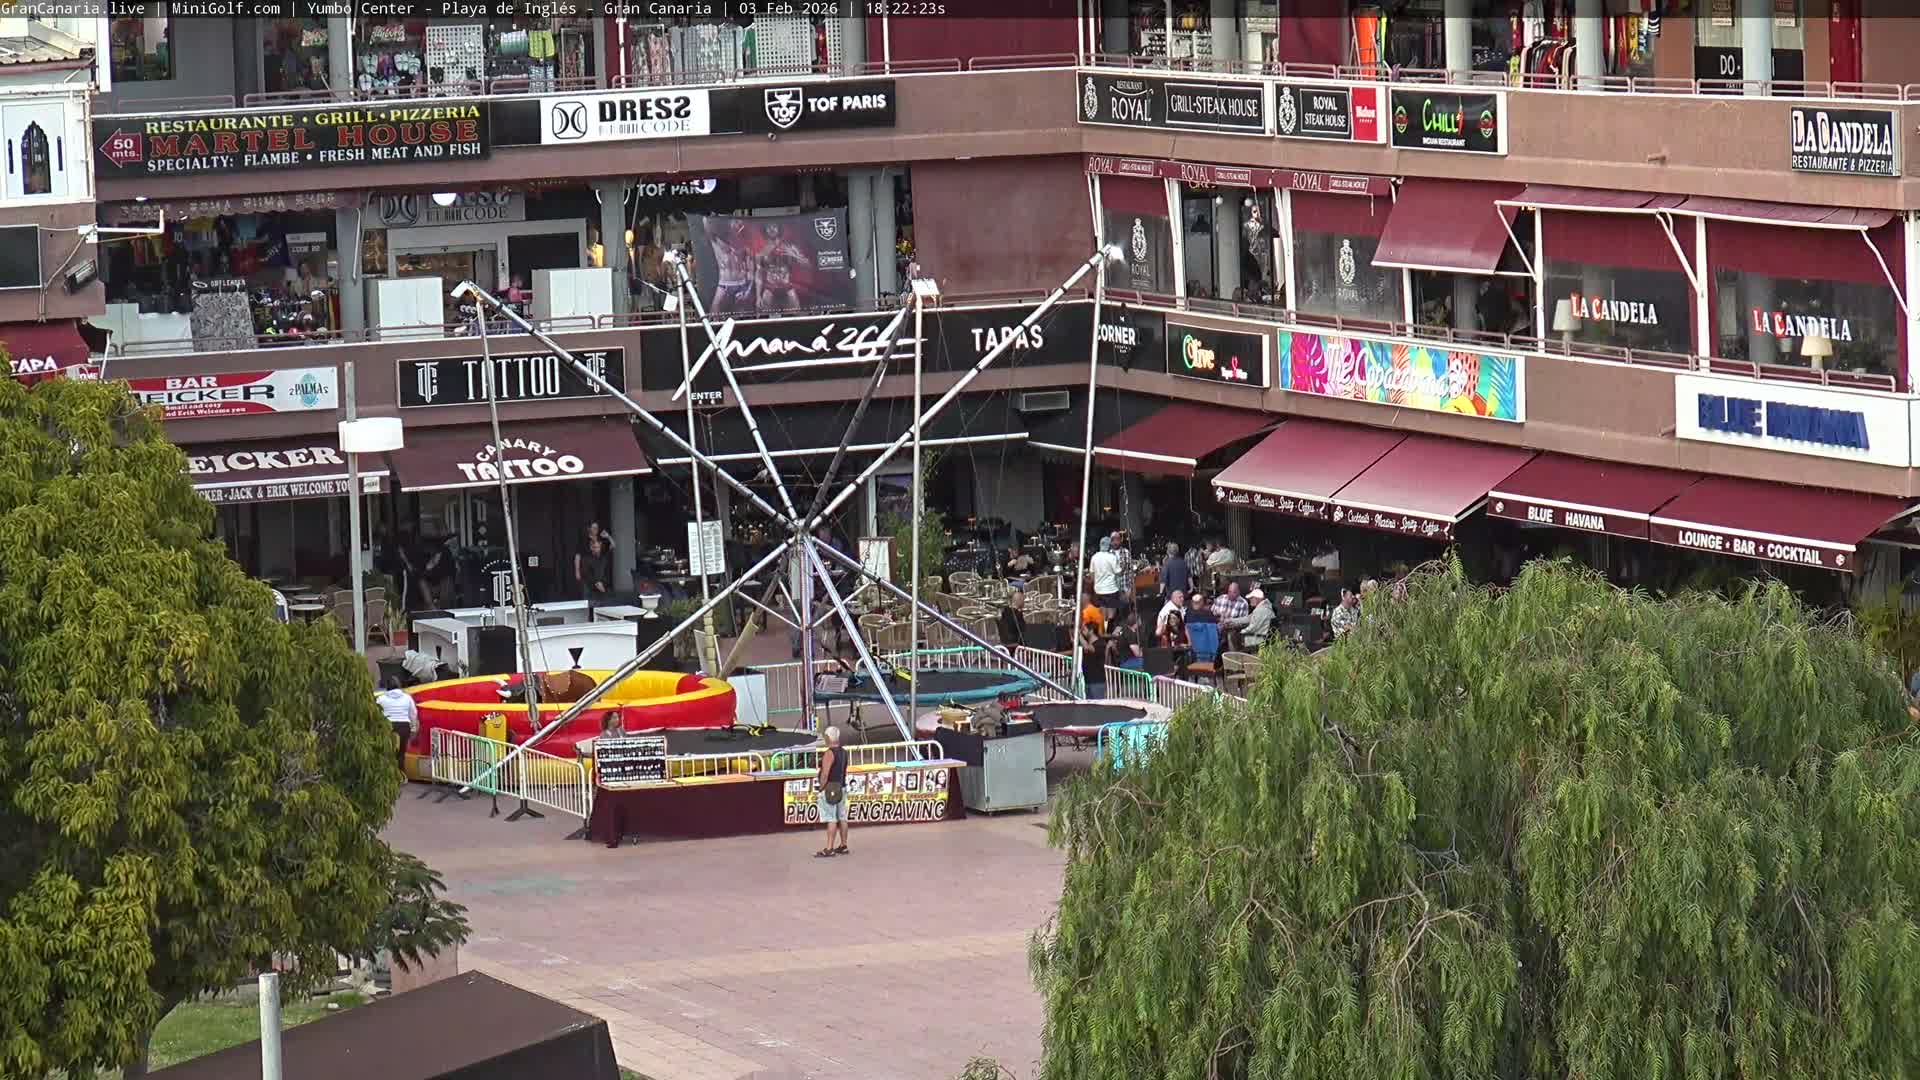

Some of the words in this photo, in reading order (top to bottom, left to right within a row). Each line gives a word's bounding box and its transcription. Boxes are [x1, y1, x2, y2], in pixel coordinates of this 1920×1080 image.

[808, 97, 838, 112] TOF
[842, 94, 887, 110] PARIS
[1111, 97, 1152, 121] ROYAL
[1229, 99, 1258, 117] HOUSE
[1313, 96, 1338, 110] ROYAL
[146, 114, 294, 134] RESTAURANTE
[315, 109, 377, 125] GRILL
[390, 105, 481, 121] PIZZERIA
[772, 106, 797, 119] TOF
[1304, 112, 1324, 125] STEAK
[1325, 113, 1346, 127] HOUSE
[641, 119, 691, 133] CODE
[113, 138, 134, 150] 50
[150, 127, 316, 158] MARTEL
[337, 119, 480, 148] HOUSE
[112, 149, 140, 159] mts.
[147, 156, 234, 173] SPECIALTY:
[244, 151, 300, 167] FLAMBE
[319, 147, 365, 163] FRESH
[371, 145, 408, 161] MEAT
[414, 144, 444, 158] AND
[450, 142, 482, 156] FISH
[1088, 156, 1114, 173] ROYAL
[1792, 154, 1848, 171] RESTAURANTE
[1858, 158, 1893, 173] PIZZERIA
[1181, 164, 1211, 182] ROYAL
[1292, 172, 1322, 190] ROYAL
[636, 182, 665, 197] TOF
[1571, 295, 1590, 318] LA
[1591, 298, 1658, 325] CANDELA
[1774, 313, 1852, 341] CANDELA
[166, 376, 219, 390] BAR
[462, 356, 560, 400] TATTOO
[691, 391, 722, 401] ENTER
[197, 408, 230, 416] Welcome
[476, 438, 556, 462] CANARY
[457, 455, 584, 481] TATTOO
[266, 484, 289, 498] ERIK
[290, 480, 335, 496] WELCOME
[1527, 506, 1554, 523] BLUE
[1565, 511, 1605, 531] HAVANA
[1678, 530, 1723, 549] LOUNGE
[1733, 538, 1756, 555] BAR
[1767, 543, 1823, 565] COCKTAIL
[847, 799, 945, 822] ENGRAVING
